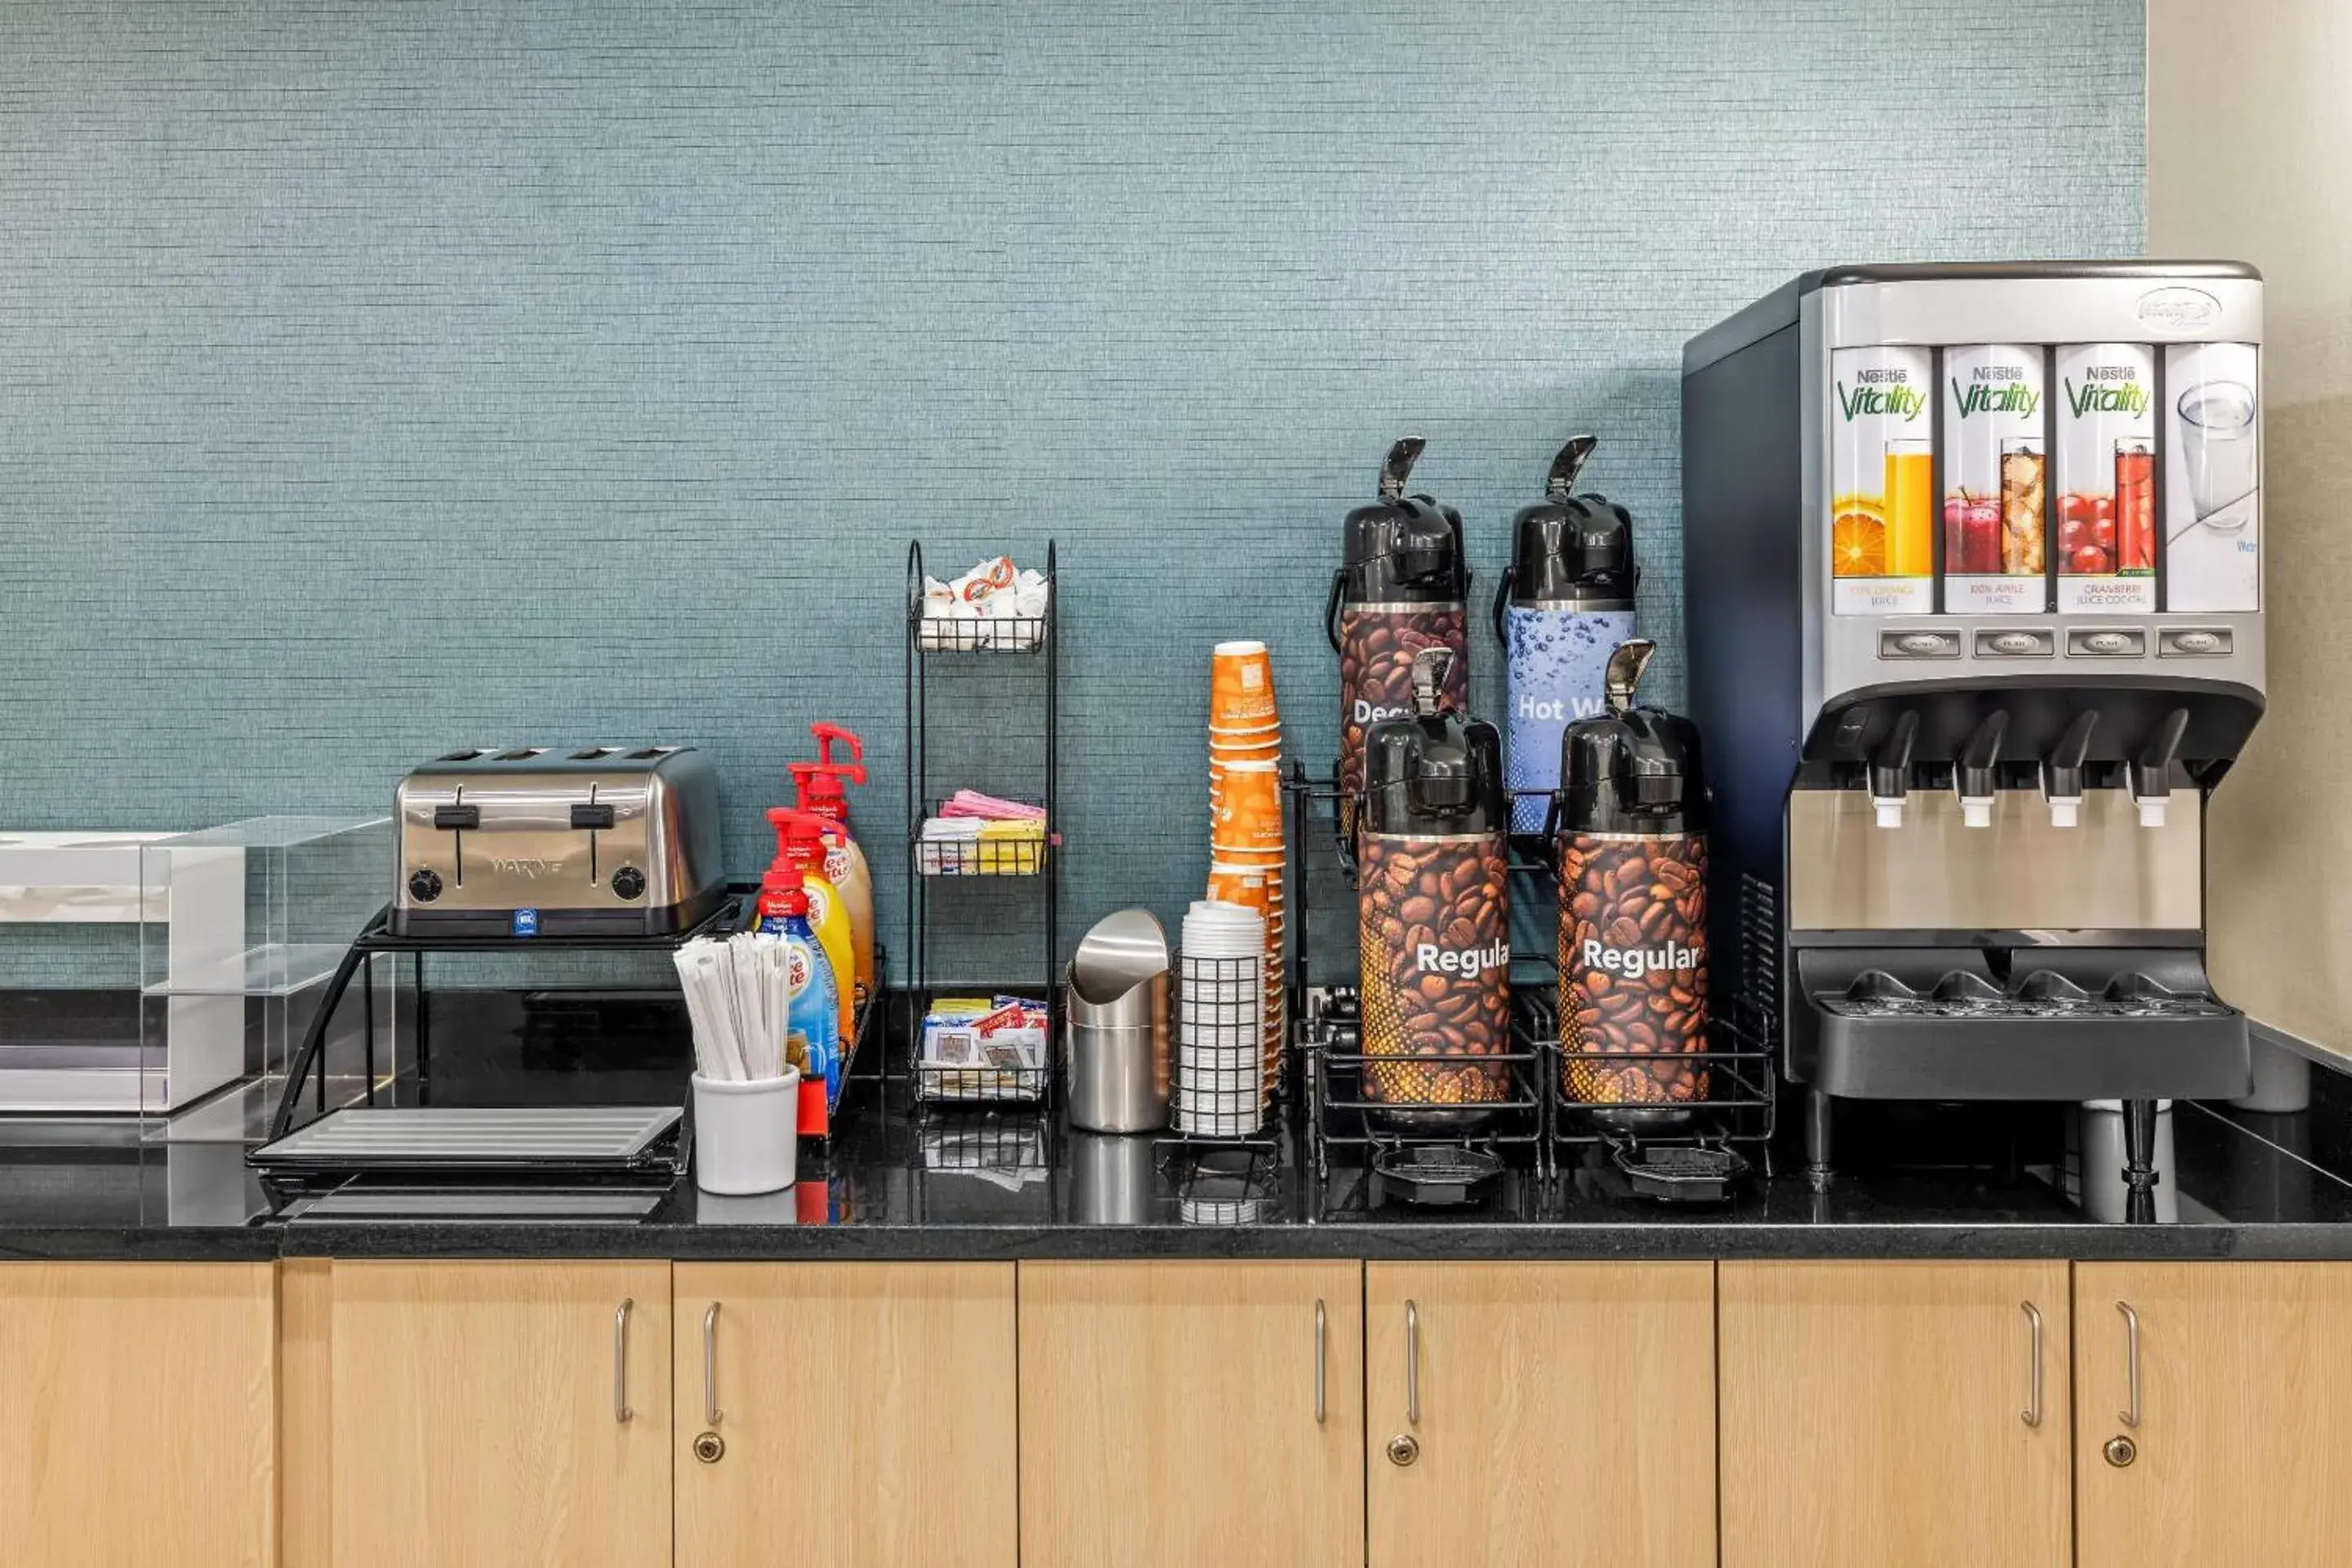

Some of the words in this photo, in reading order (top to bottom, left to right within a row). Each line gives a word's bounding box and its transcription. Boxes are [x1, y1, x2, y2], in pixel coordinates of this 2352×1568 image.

[1838, 380, 1927, 422] Vitality
[1952, 376, 2041, 420] Vitality
[2065, 376, 2150, 420] Vitality
[1518, 694, 1564, 720] Hot
[1417, 938, 1509, 978] Regula
[1583, 939, 1699, 978] Regular
